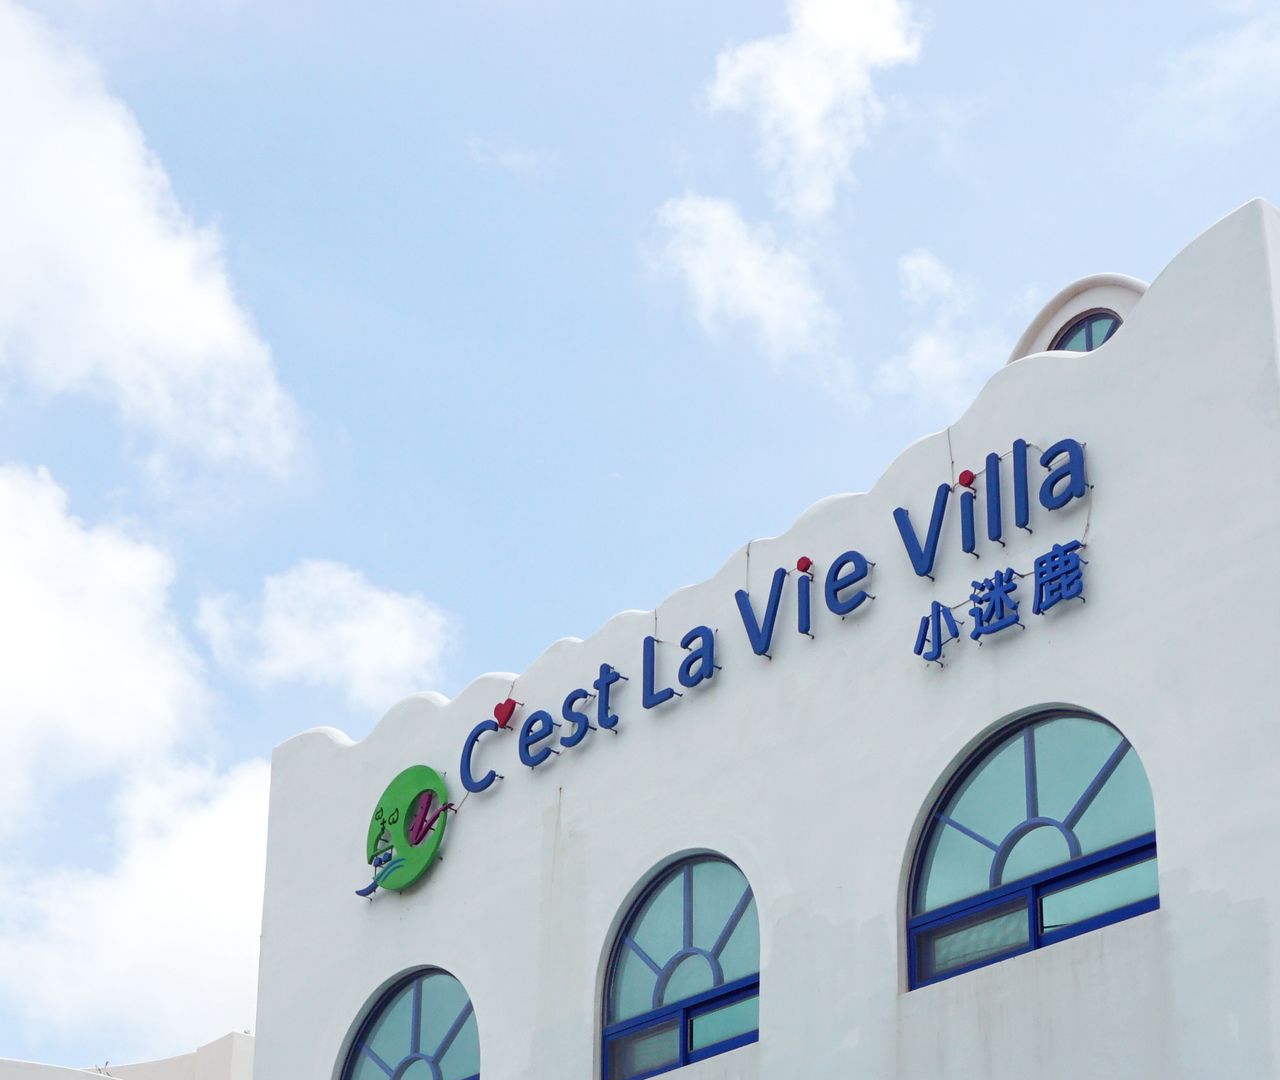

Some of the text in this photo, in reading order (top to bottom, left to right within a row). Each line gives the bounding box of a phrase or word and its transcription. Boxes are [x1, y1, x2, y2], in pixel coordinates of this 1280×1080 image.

[641, 625, 717, 711] La
[735, 549, 870, 656] Vie
[893, 437, 1087, 579] Villa
[913, 539, 1084, 662] 小迷鹿
